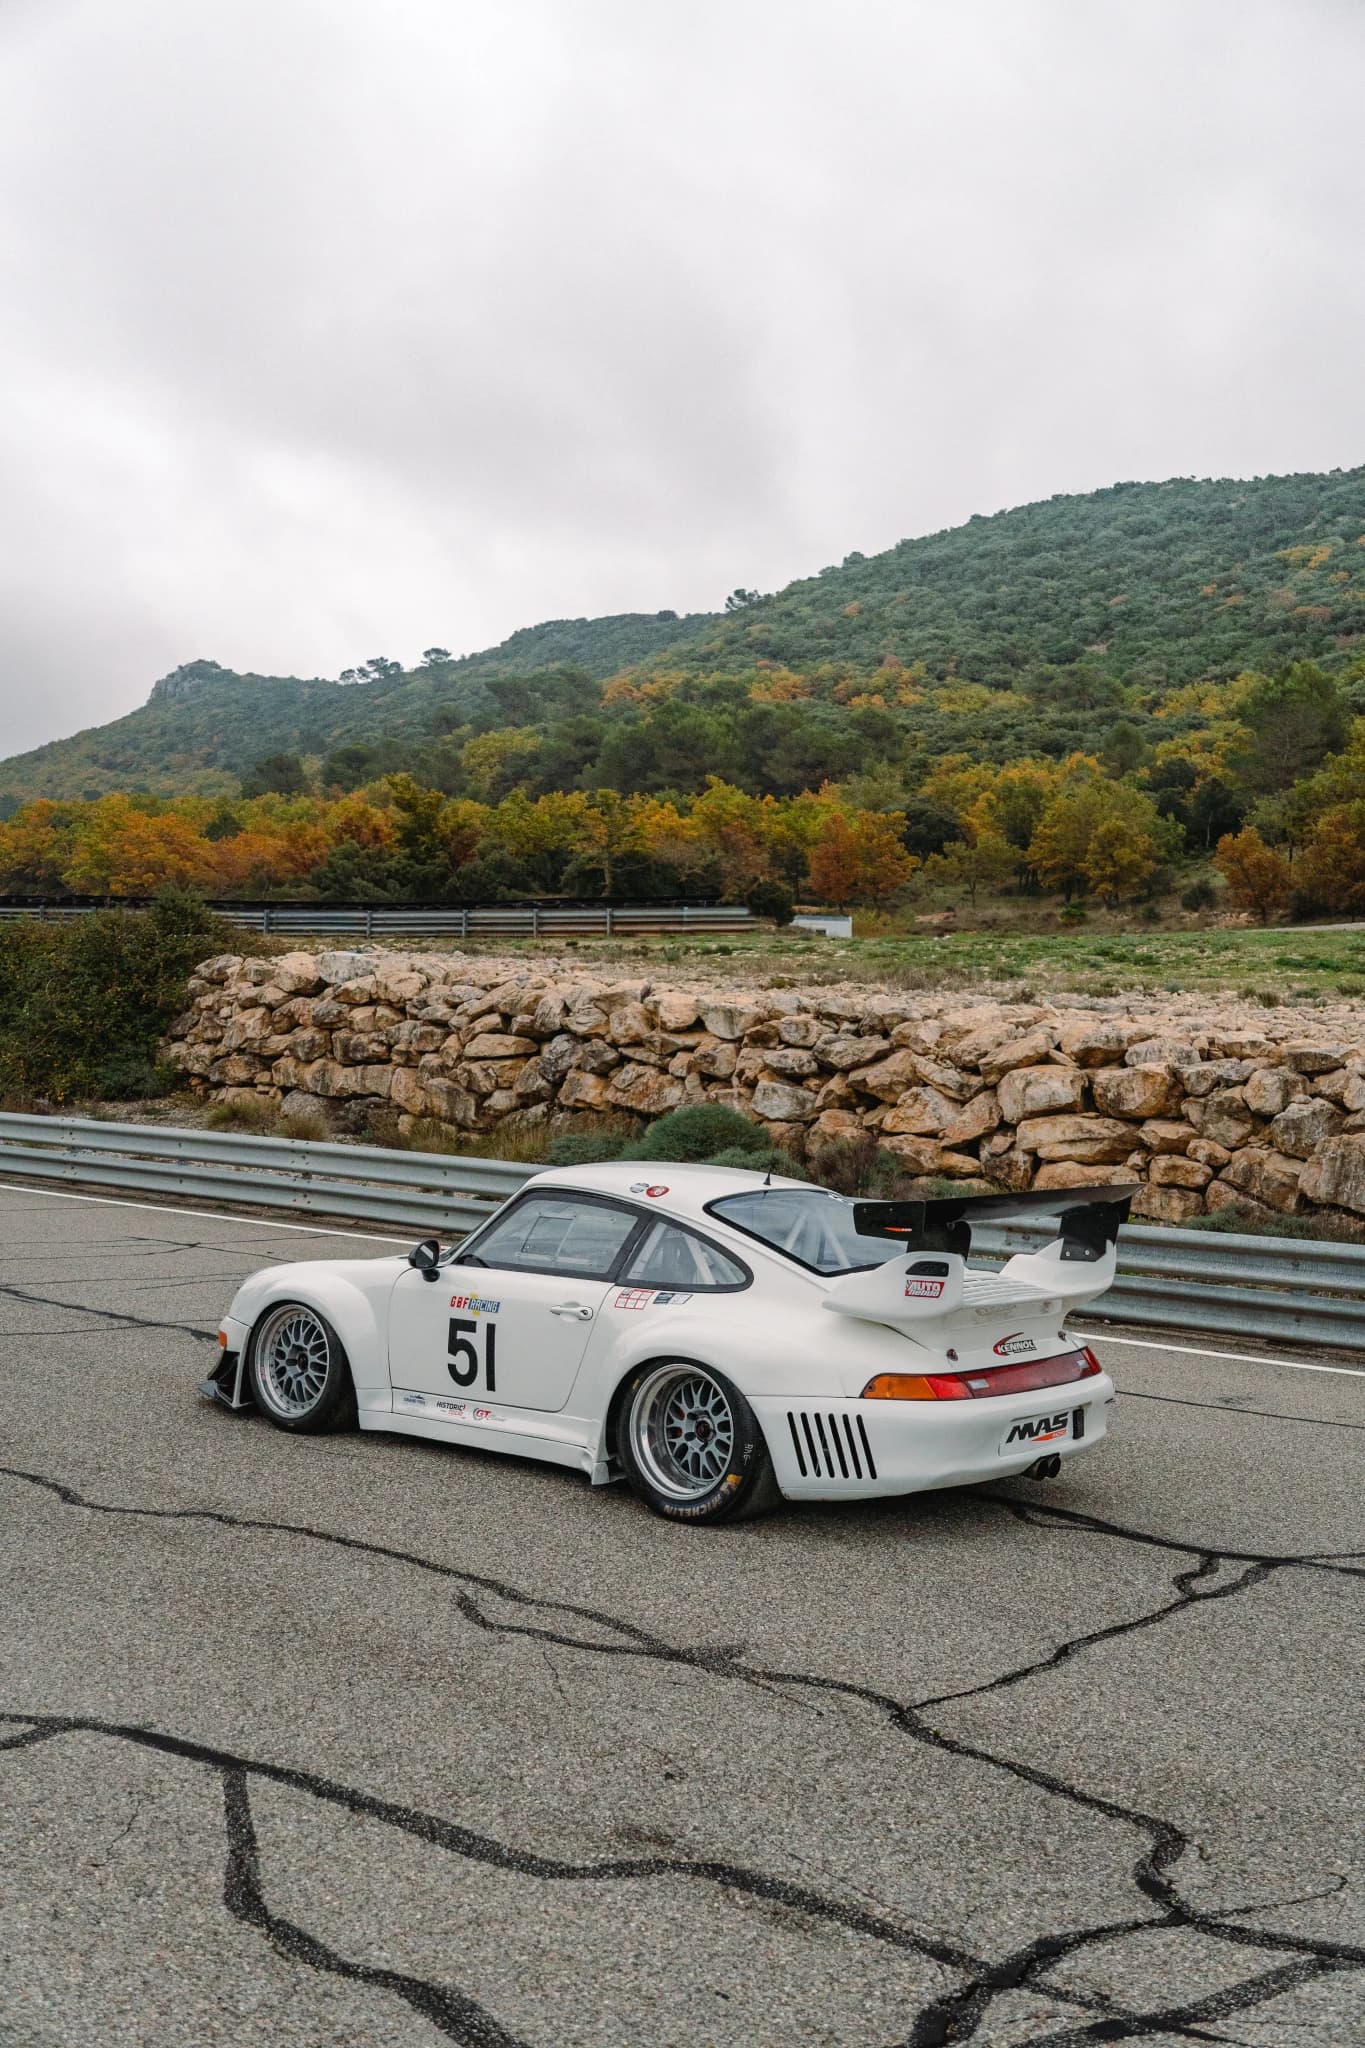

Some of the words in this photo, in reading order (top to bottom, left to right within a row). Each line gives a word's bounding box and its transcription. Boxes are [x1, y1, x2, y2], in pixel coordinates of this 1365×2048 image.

[910, 1281, 942, 1292] AUTO
[450, 1296, 469, 1309] GBF
[469, 1299, 500, 1313] RACING
[447, 1317, 496, 1392] 51
[476, 1409, 491, 1418] GT
[1005, 1411, 1069, 1443] MAS
[663, 1494, 721, 1517] MICHELIN
